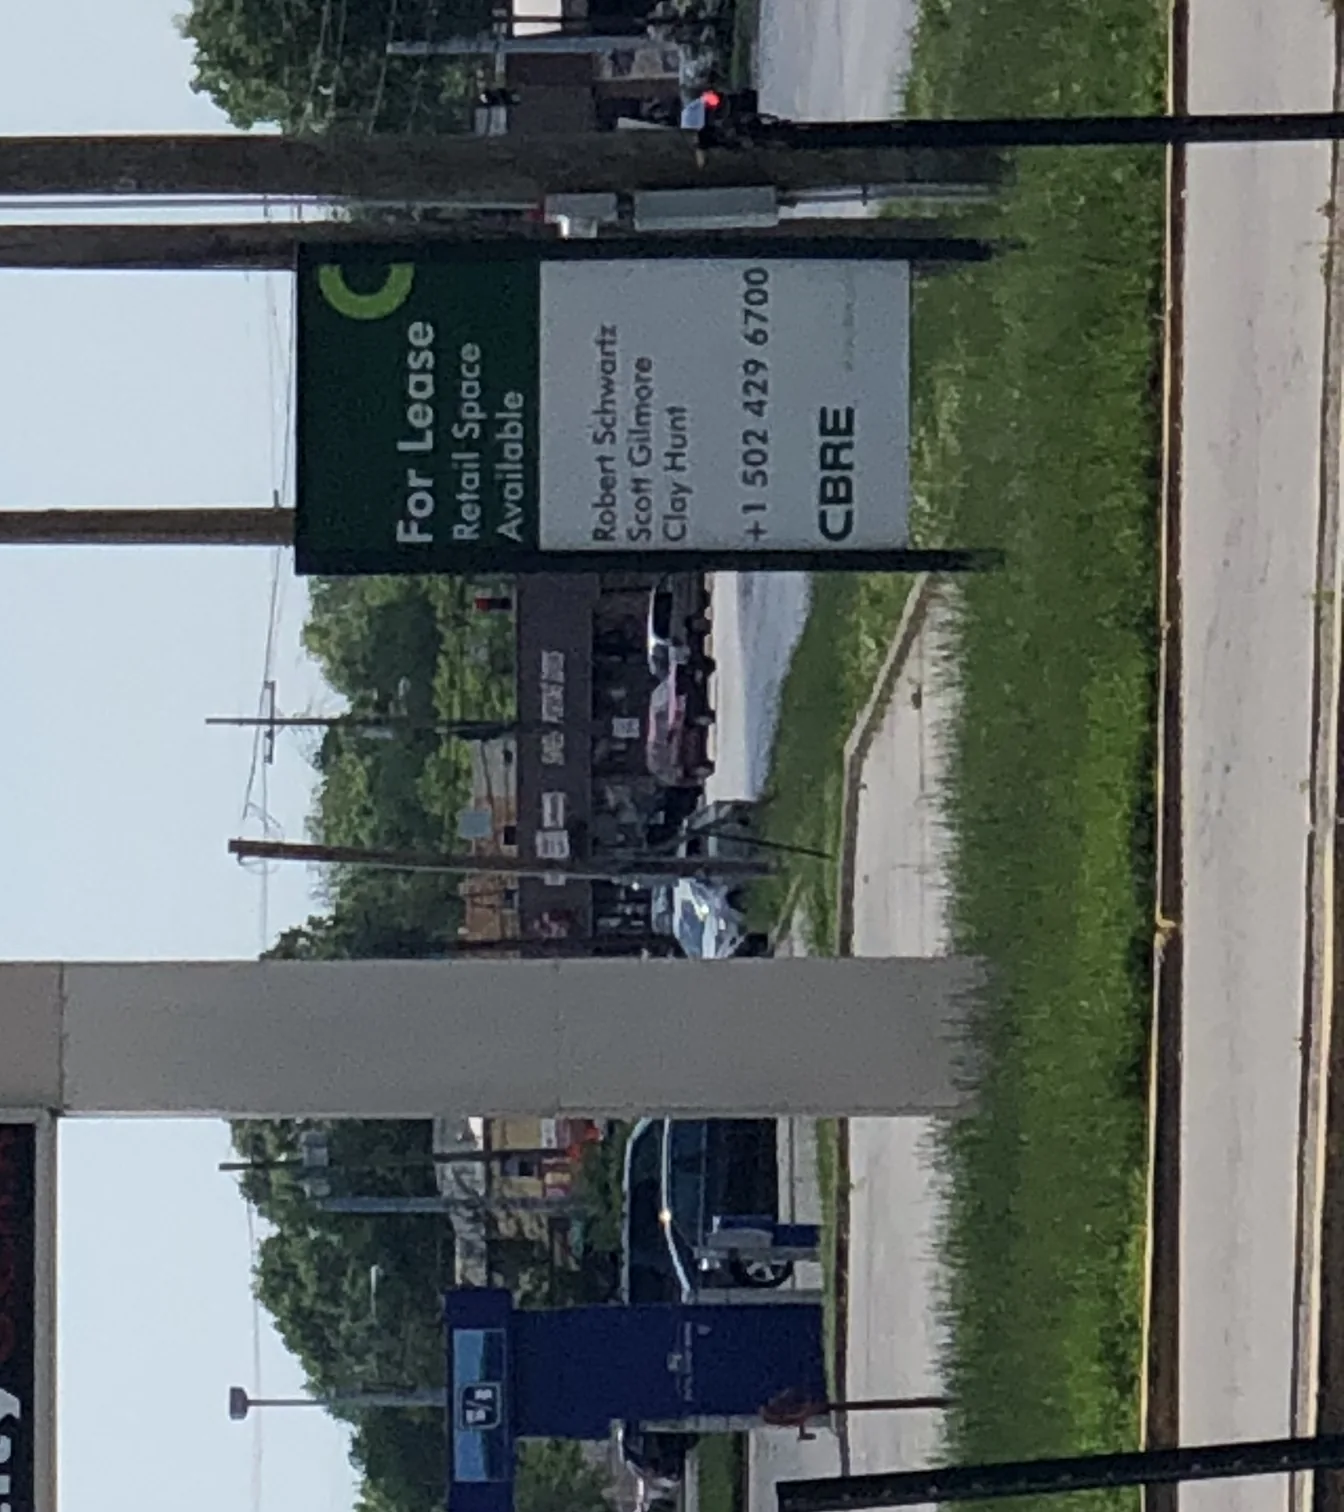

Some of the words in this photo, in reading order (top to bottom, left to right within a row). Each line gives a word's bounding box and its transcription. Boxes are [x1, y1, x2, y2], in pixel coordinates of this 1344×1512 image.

[742, 266, 769, 347] 6700
[397, 321, 436, 451] Lease
[452, 343, 488, 440] Space
[592, 323, 617, 445] Schwartz
[628, 356, 654, 467] Gilmore
[742, 358, 769, 418] 429
[495, 391, 524, 542] Available
[663, 405, 689, 472] Hunt
[742, 428, 769, 488] 502
[818, 405, 854, 542] CBRE
[396, 468, 435, 543] For
[452, 451, 480, 540] Retail
[592, 454, 616, 542] Robert
[628, 477, 654, 542] Scott
[663, 479, 694, 542] Clay
[742, 502, 769, 542] +1
